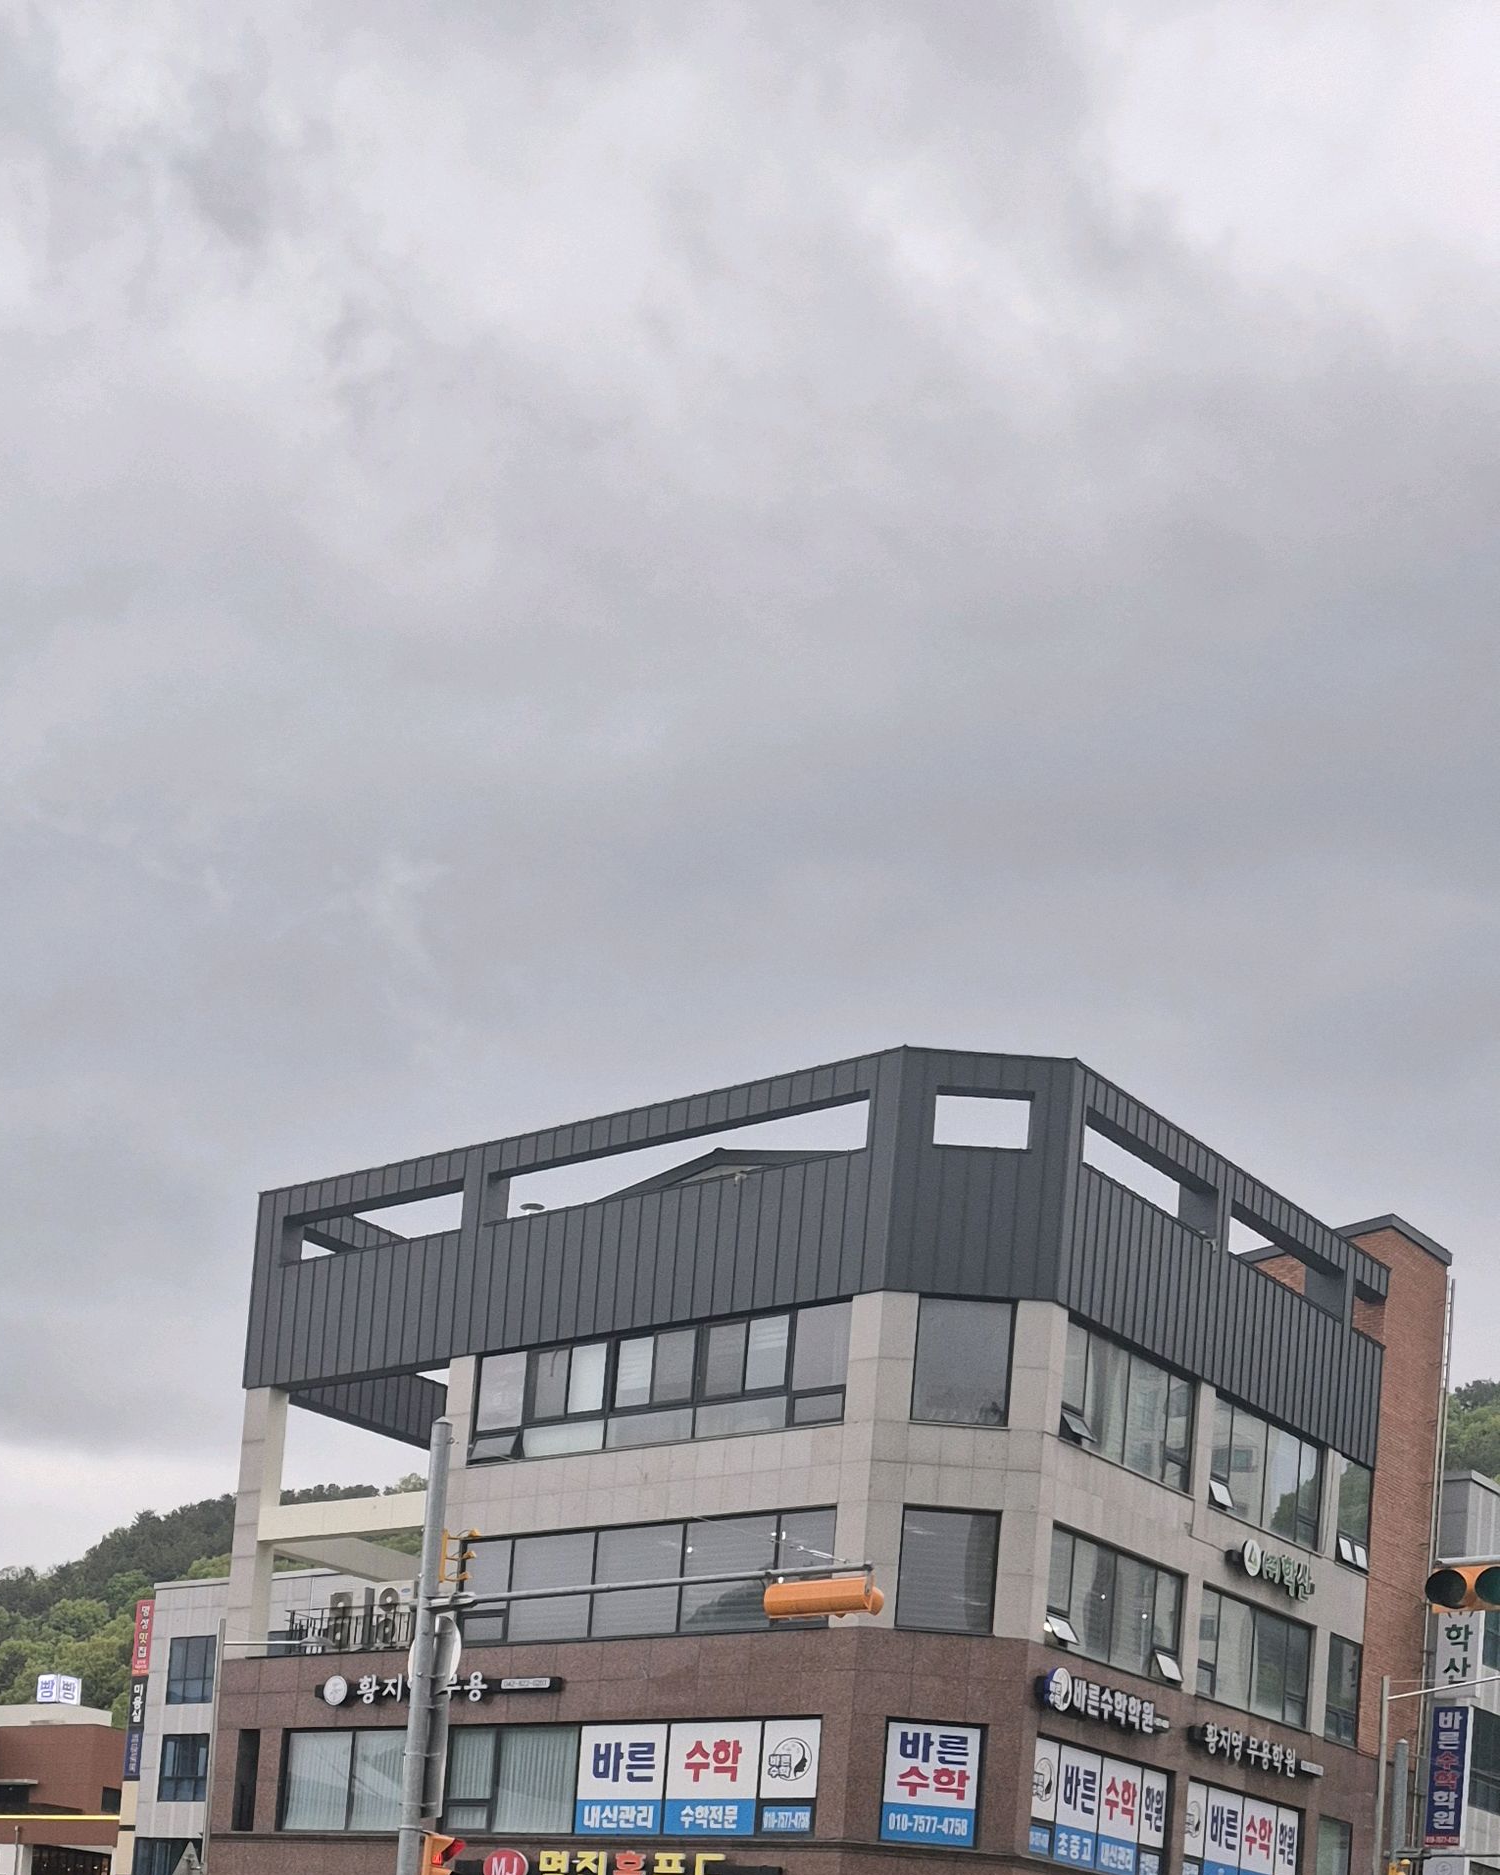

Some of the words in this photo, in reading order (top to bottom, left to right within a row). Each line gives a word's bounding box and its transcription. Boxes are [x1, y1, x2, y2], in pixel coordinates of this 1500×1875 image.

[1073, 1678, 1154, 1734] 바른수학학원
[592, 1742, 656, 1783] 바른
[683, 1739, 742, 1783] 수학
[899, 1731, 969, 1766] 바른
[897, 1766, 970, 1801] 수학
[1063, 1763, 1097, 1816] 바른
[1104, 1776, 1138, 1826] 수학
[1144, 1785, 1164, 1833] 학원
[583, 1805, 654, 1830] 내신관리
[680, 1805, 737, 1829] 수학전문
[888, 1812, 968, 1836] 010-7577-4758
[1057, 1832, 1092, 1861] 초중고
[1210, 1804, 1238, 1851] 바른
[1244, 1814, 1273, 1860] 수학
[1278, 1822, 1295, 1867] 학원
